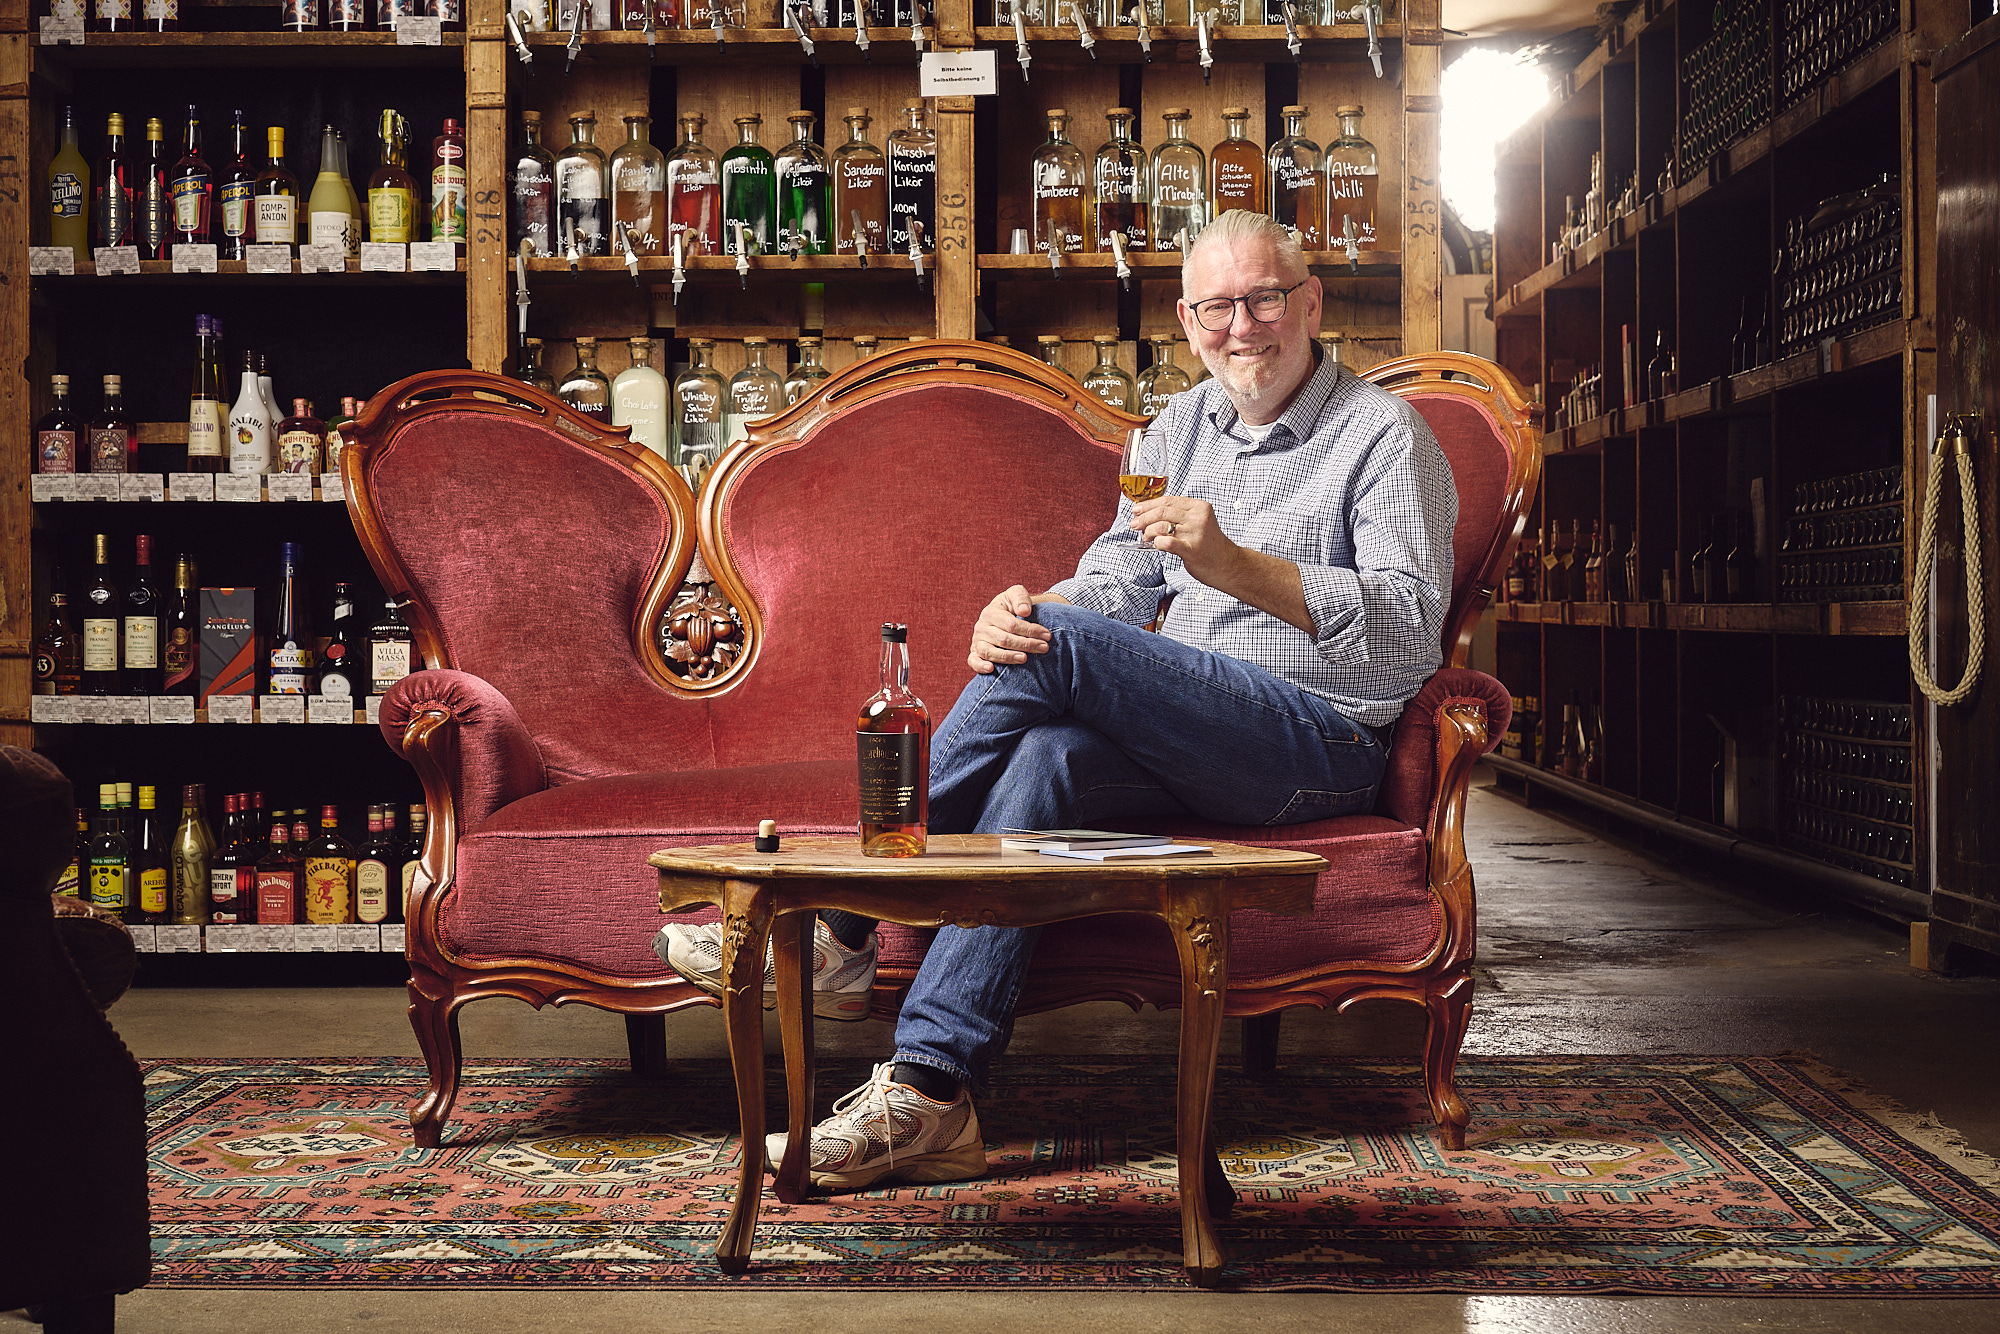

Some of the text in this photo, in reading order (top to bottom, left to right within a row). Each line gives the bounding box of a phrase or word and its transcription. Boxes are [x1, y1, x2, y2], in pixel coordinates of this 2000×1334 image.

[893, 143, 927, 159] Kirsch
[683, 160, 702, 172] Pink
[726, 159, 768, 175] Absinth
[893, 159, 936, 174] Koriand
[1104, 160, 1136, 179] Altes
[1161, 163, 1191, 181] Alte
[1221, 163, 1245, 173] Alte
[1331, 161, 1368, 179] Alter
[791, 177, 814, 188] Likör
[848, 176, 873, 189] Likör
[894, 175, 924, 188] Likör
[1219, 173, 1253, 182] schwarze
[173, 180, 203, 195] APEROL
[221, 186, 251, 201] APEROL
[683, 183, 705, 194] Likör
[1034, 184, 1080, 199] Himbeere
[1159, 184, 1205, 202] Mirabelle
[1223, 189, 1246, 198] beere
[1331, 178, 1364, 200] Willi
[260, 203, 287, 213] COMP-
[893, 202, 918, 216] 100ml
[1407, 175, 1438, 239] 257
[260, 213, 287, 221] ANION
[475, 190, 502, 244] 218
[940, 193, 969, 252] 256
[526, 221, 548, 233] 18%
[867, 220, 879, 230] 100
[838, 239, 854, 250] 20%
[1157, 240, 1175, 251] 40%
[622, 397, 640, 409] Chai
[681, 391, 717, 406] Whisky
[1142, 392, 1176, 410] Grapp
[686, 403, 714, 414] Sahne
[740, 403, 768, 413] Sahne
[232, 416, 265, 432] MALIBU
[683, 412, 710, 424] Likör
[379, 647, 405, 655] VILLA
[377, 654, 406, 662] MASSA
[37, 658, 48, 672] 43
[376, 679, 400, 687] AMARE
[307, 862, 347, 877] FIREBALL
[176, 856, 184, 912] CARAMELO
[211, 873, 234, 882] UTHERN
[211, 881, 232, 890] MFORT
[258, 879, 272, 890] JACK
